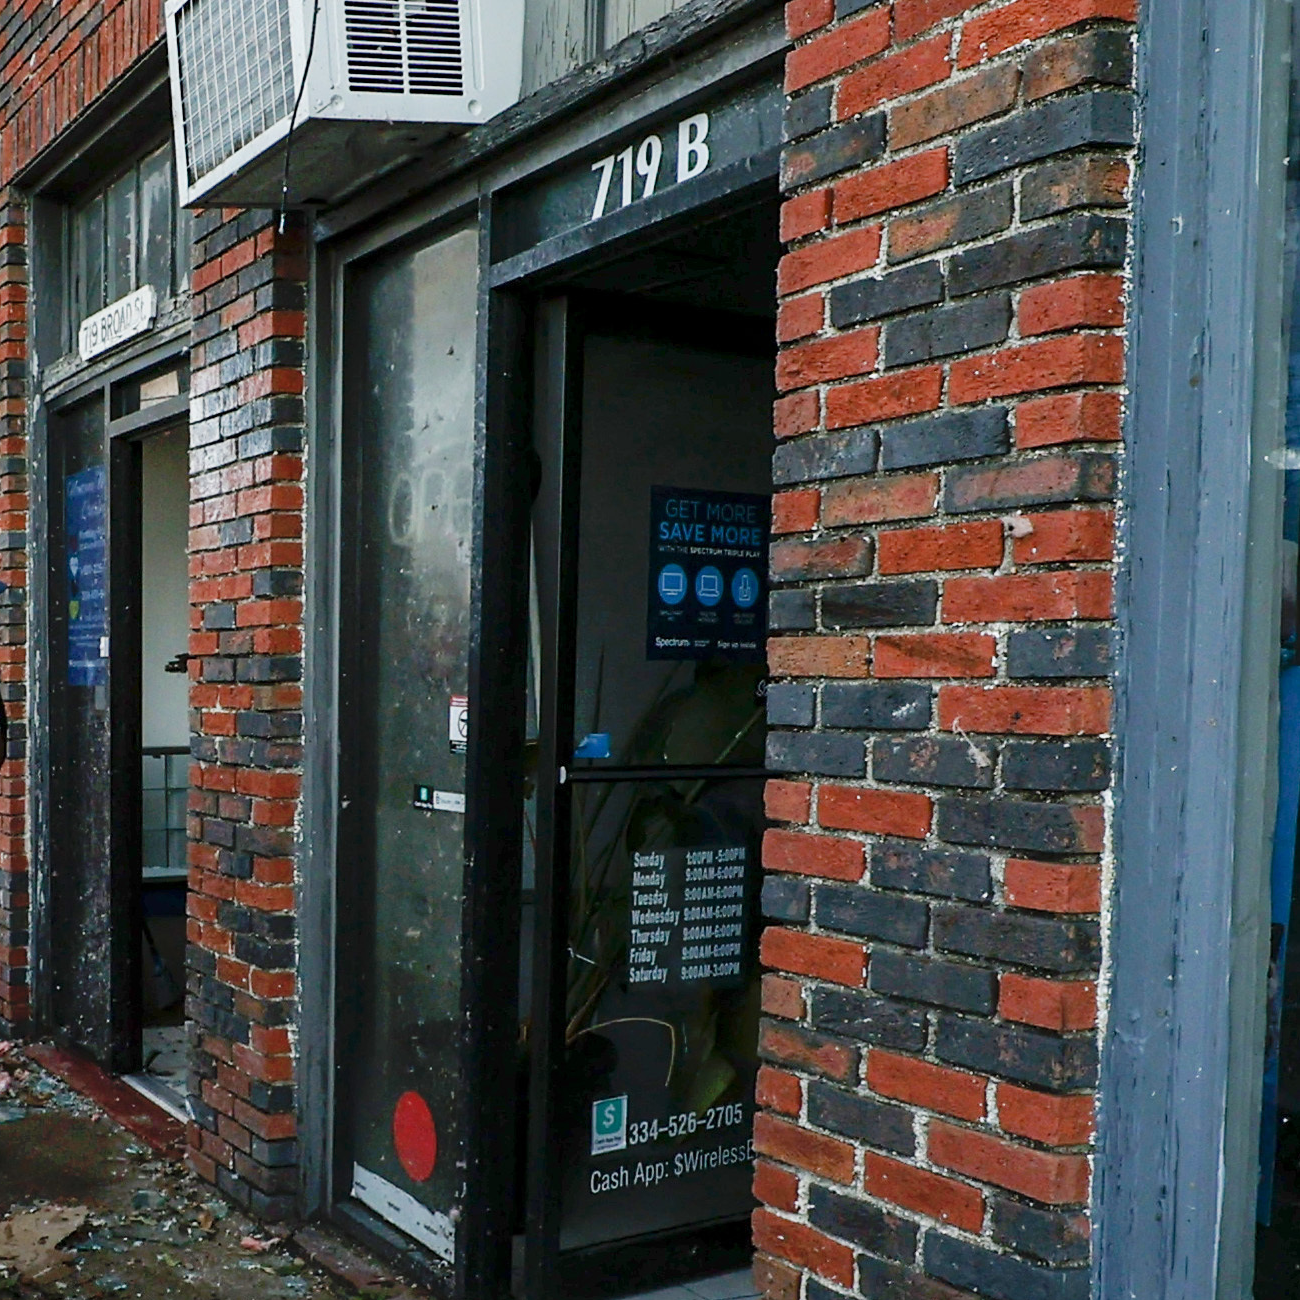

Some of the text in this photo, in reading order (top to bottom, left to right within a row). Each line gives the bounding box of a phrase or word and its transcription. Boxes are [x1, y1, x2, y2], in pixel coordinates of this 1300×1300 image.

[591, 112, 709, 220] 719 B
[83, 320, 98, 353] 719
[100, 303, 133, 342] BROAD
[665, 499, 757, 523] GET MORE
[659, 521, 762, 546] SAVE MORE
[690, 546, 723, 556] SPECTRUM
[724, 548, 744, 557] TRIPLE
[745, 550, 761, 559] PLAY
[655, 636, 689, 649] Spectrum
[634, 851, 665, 870] Sunday
[633, 871, 666, 889] Monday
[633, 890, 669, 908] Tuesday
[631, 908, 680, 926] Wednesday
[631, 927, 671, 946] Thursday
[629, 947, 657, 965] Friday
[629, 962, 740, 984] Saturday 9:00AM-3:00PM
[629, 1103, 743, 1145] 334-526-2705
[590, 1165, 629, 1194] Cash
[633, 1161, 669, 1188] App:
